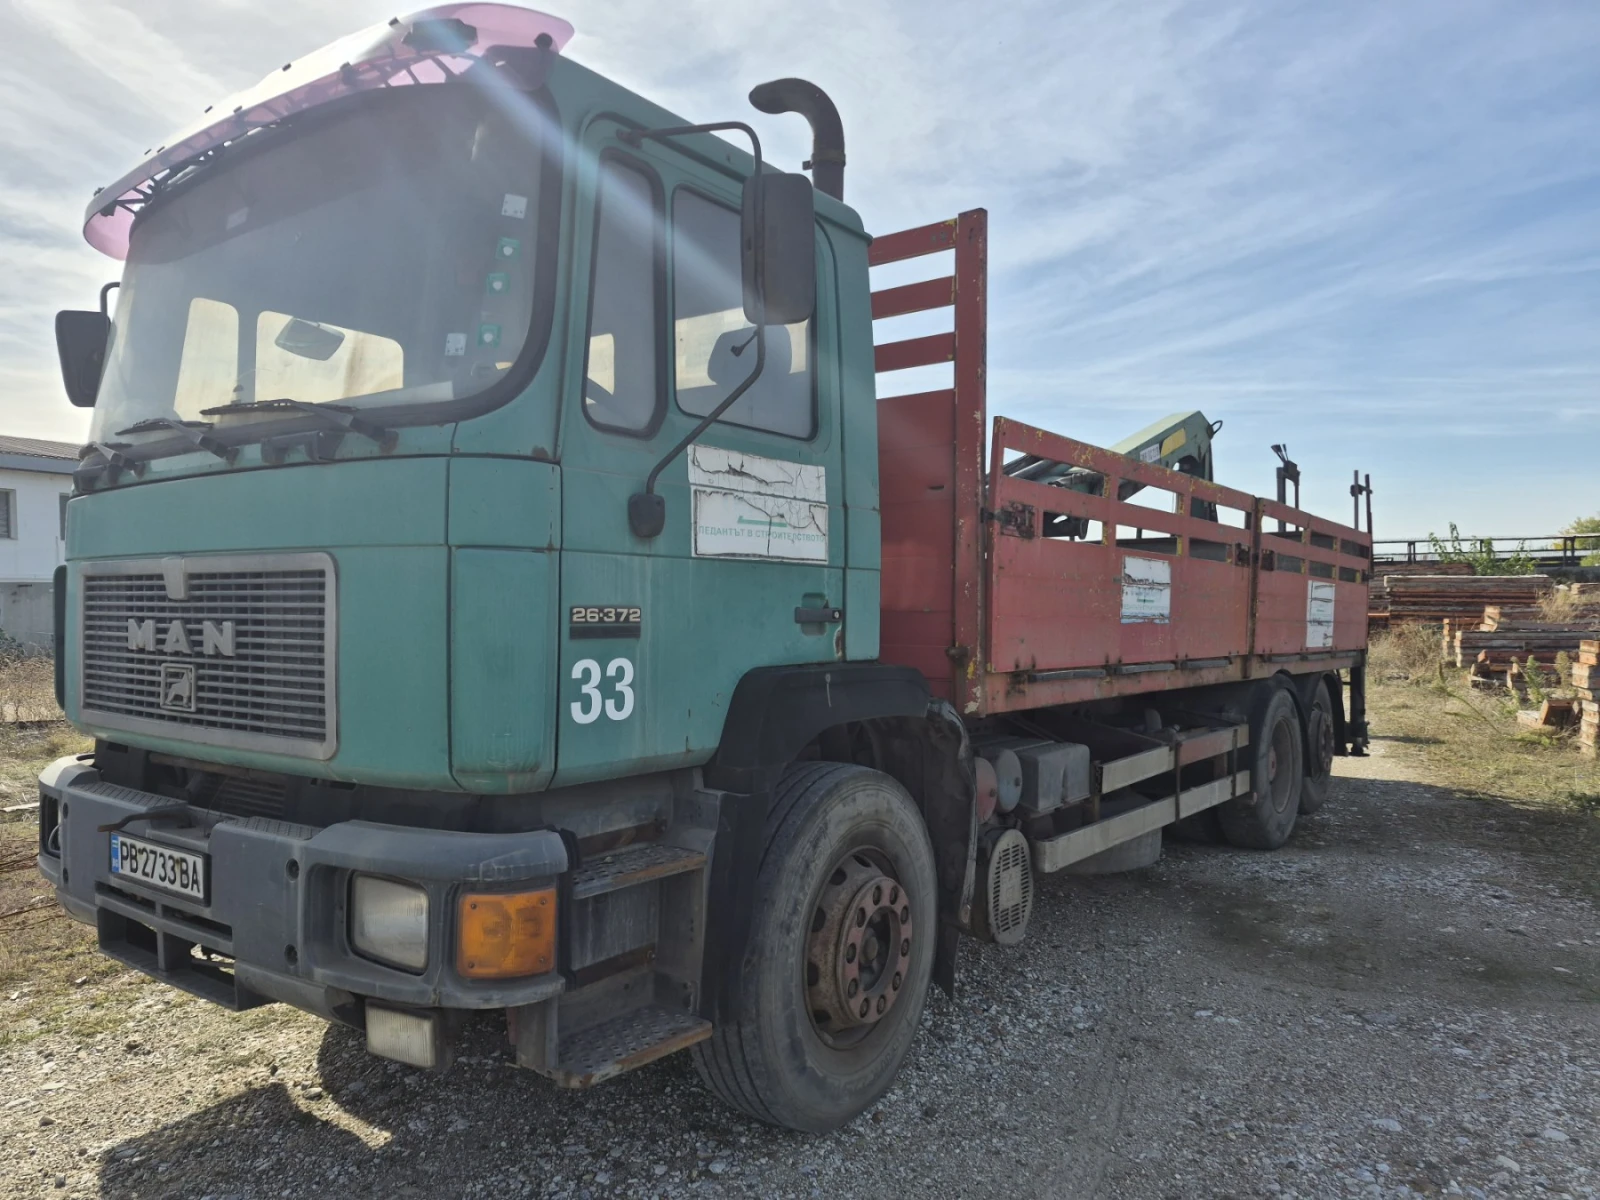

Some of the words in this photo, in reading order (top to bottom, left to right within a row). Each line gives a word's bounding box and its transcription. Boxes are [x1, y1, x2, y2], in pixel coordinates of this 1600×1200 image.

[698, 525, 745, 538] ПЕДАНТЪТ
[127, 618, 236, 657] MAN
[570, 657, 635, 724] 33
